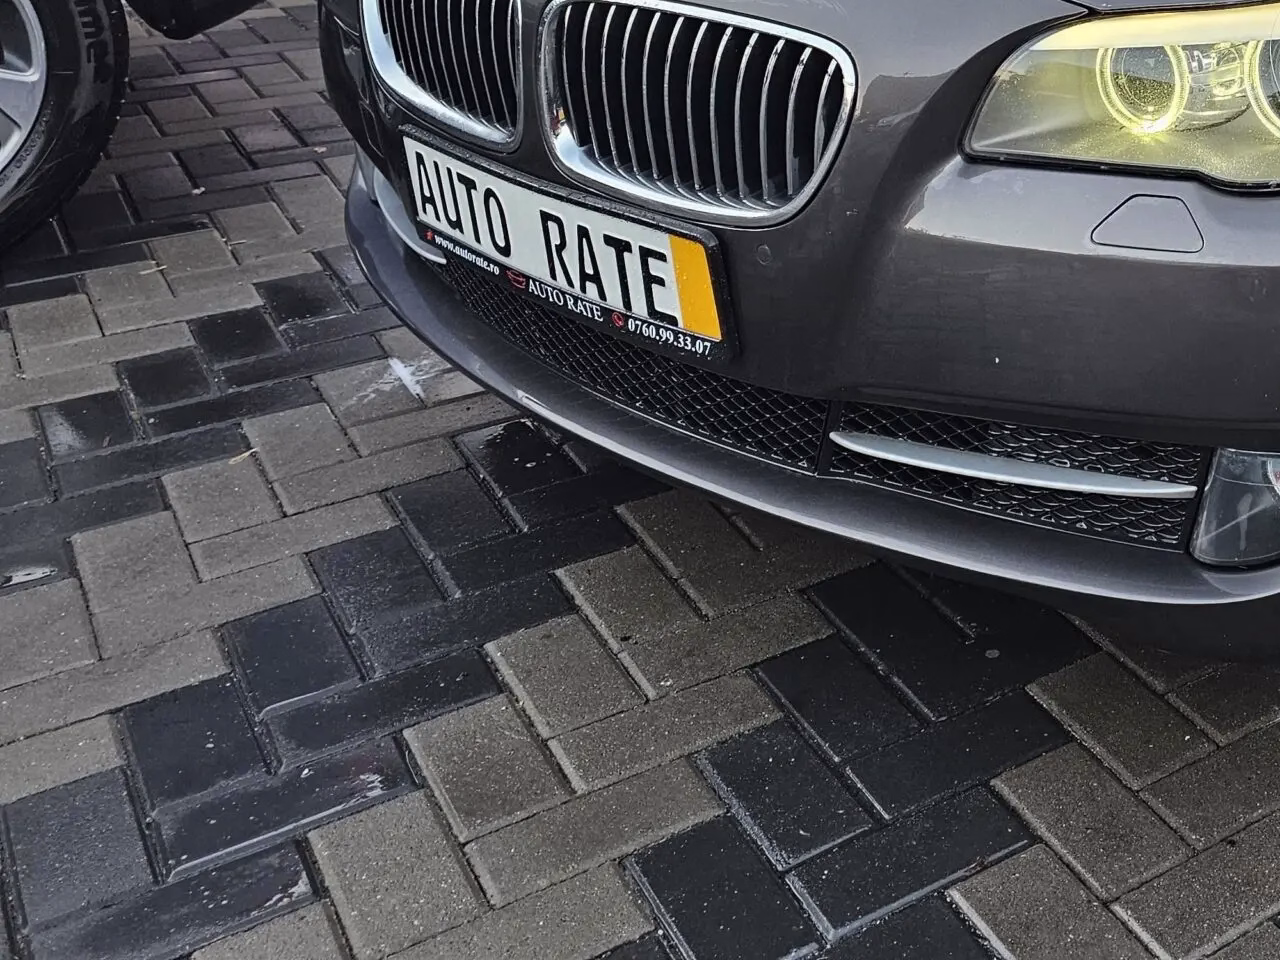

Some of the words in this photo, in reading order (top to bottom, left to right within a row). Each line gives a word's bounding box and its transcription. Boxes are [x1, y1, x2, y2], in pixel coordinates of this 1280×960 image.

[415, 151, 512, 258] AUTO
[539, 209, 680, 329] RATE
[434, 234, 500, 276] www.autorate.ro
[528, 281, 564, 307] AUTO
[566, 298, 604, 323] RATE
[627, 317, 712, 357] 0760.99.33.07
